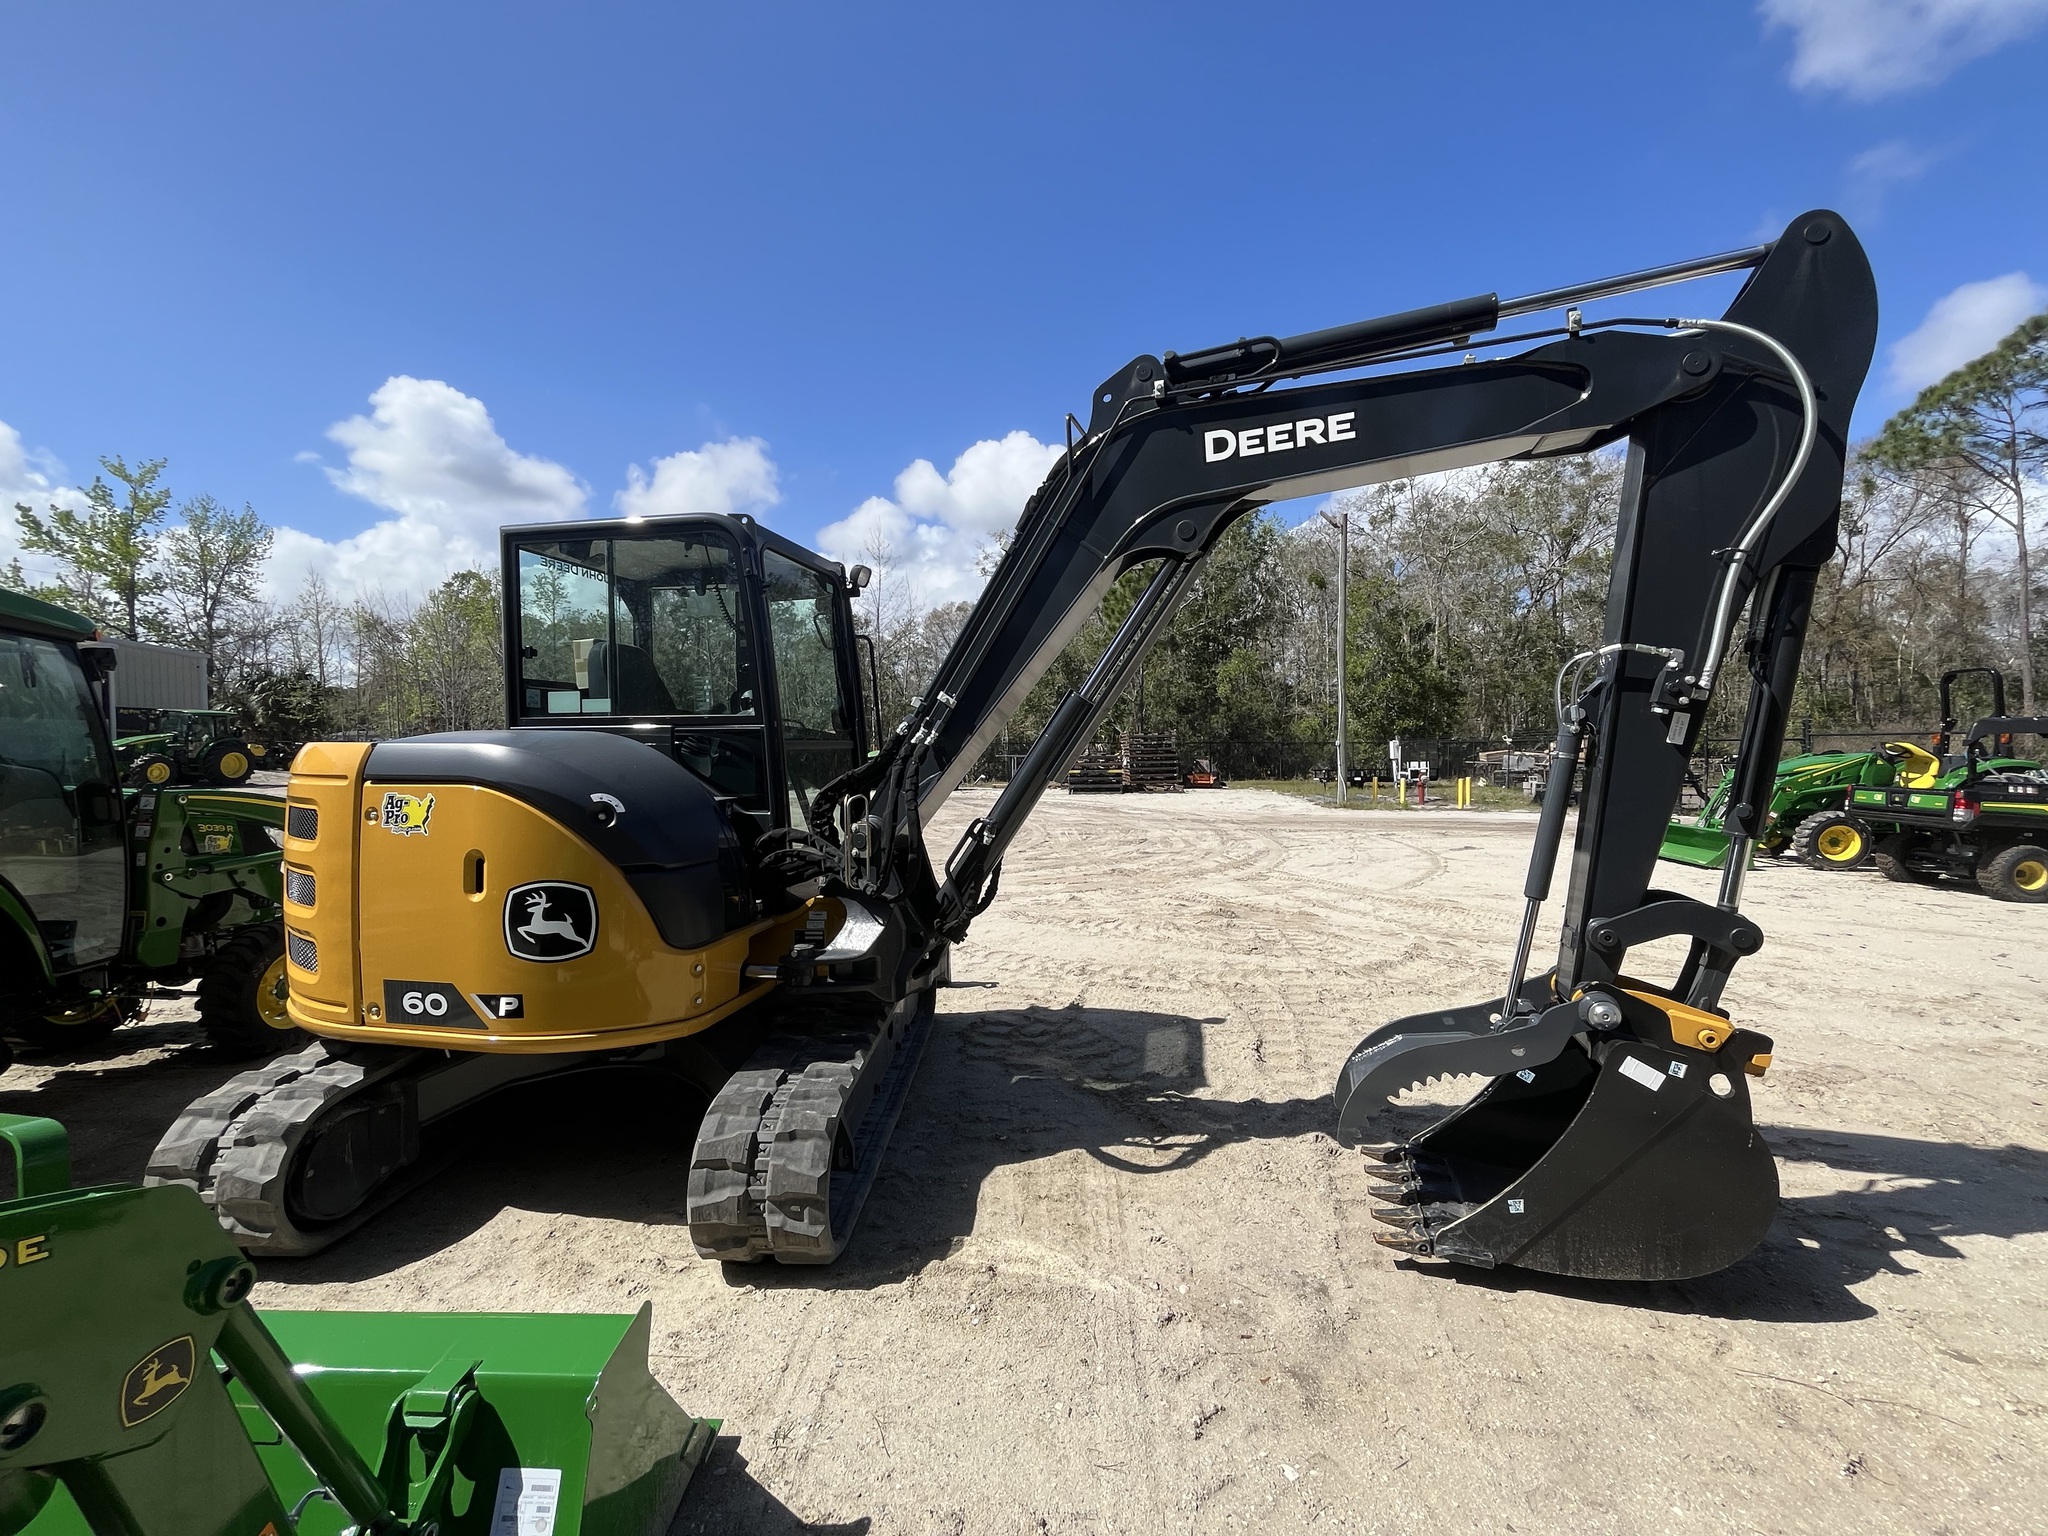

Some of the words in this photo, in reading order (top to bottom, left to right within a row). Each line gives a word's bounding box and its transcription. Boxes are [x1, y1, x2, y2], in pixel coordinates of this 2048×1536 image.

[1204, 411, 1357, 463] DEERE
[384, 795, 409, 812] Ag-
[384, 810, 409, 825] Pro
[197, 823, 226, 833] 3039
[402, 991, 448, 1016] 60
[498, 997, 519, 1017] P
